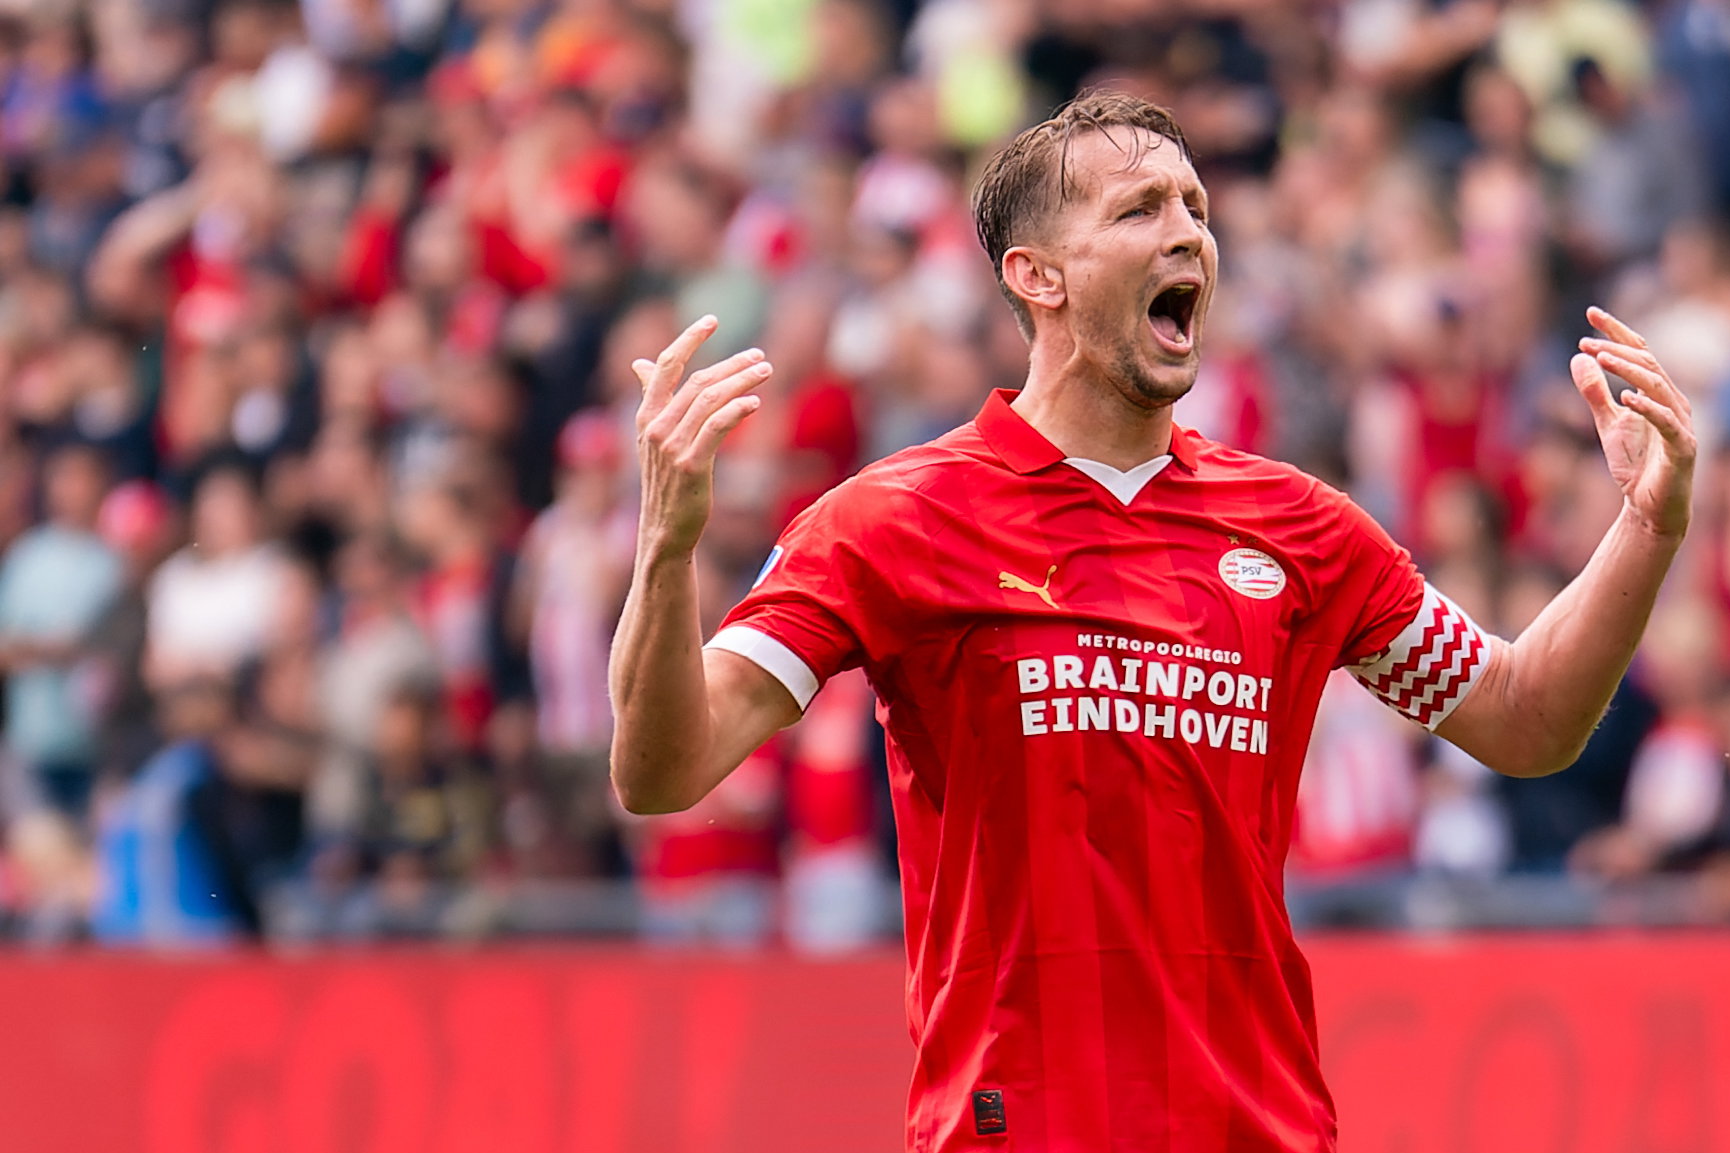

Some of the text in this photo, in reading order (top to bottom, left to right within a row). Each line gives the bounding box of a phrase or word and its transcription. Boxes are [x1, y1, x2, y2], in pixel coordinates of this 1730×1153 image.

[1241, 566, 1262, 576] PSV
[1077, 633, 1242, 665] METROPOOLREGIO
[1016, 654, 1273, 712] BRAINPORT
[1020, 696, 1268, 755] EINDHOVEN
